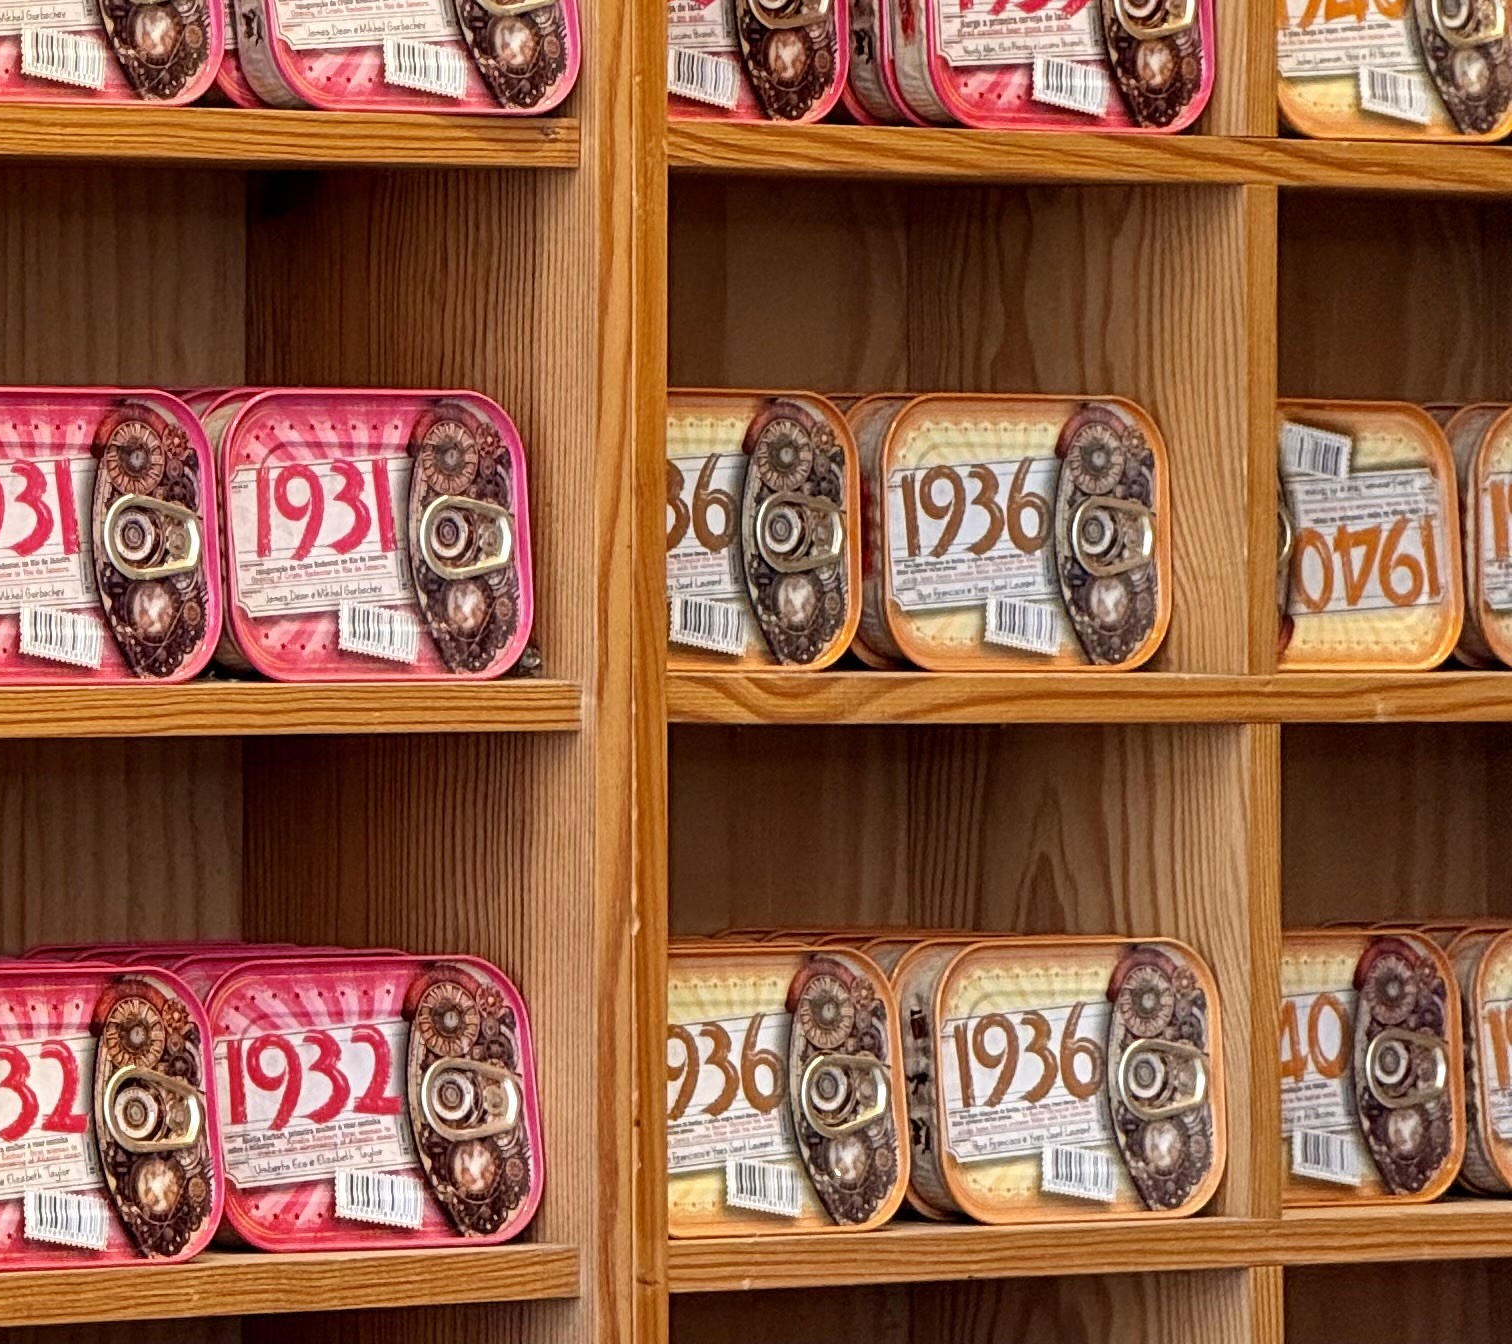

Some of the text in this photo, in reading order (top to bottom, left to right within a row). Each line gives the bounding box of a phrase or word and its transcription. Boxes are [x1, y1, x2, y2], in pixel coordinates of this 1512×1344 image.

[256, 457, 399, 561] 1931
[667, 452, 738, 553] 36
[901, 456, 1051, 560] 1936
[1293, 514, 1442, 613] 1940
[227, 1025, 401, 1130] 1932
[668, 1012, 785, 1121] 936
[955, 1001, 1103, 1108] 1936
[1281, 992, 1352, 1084] 40
